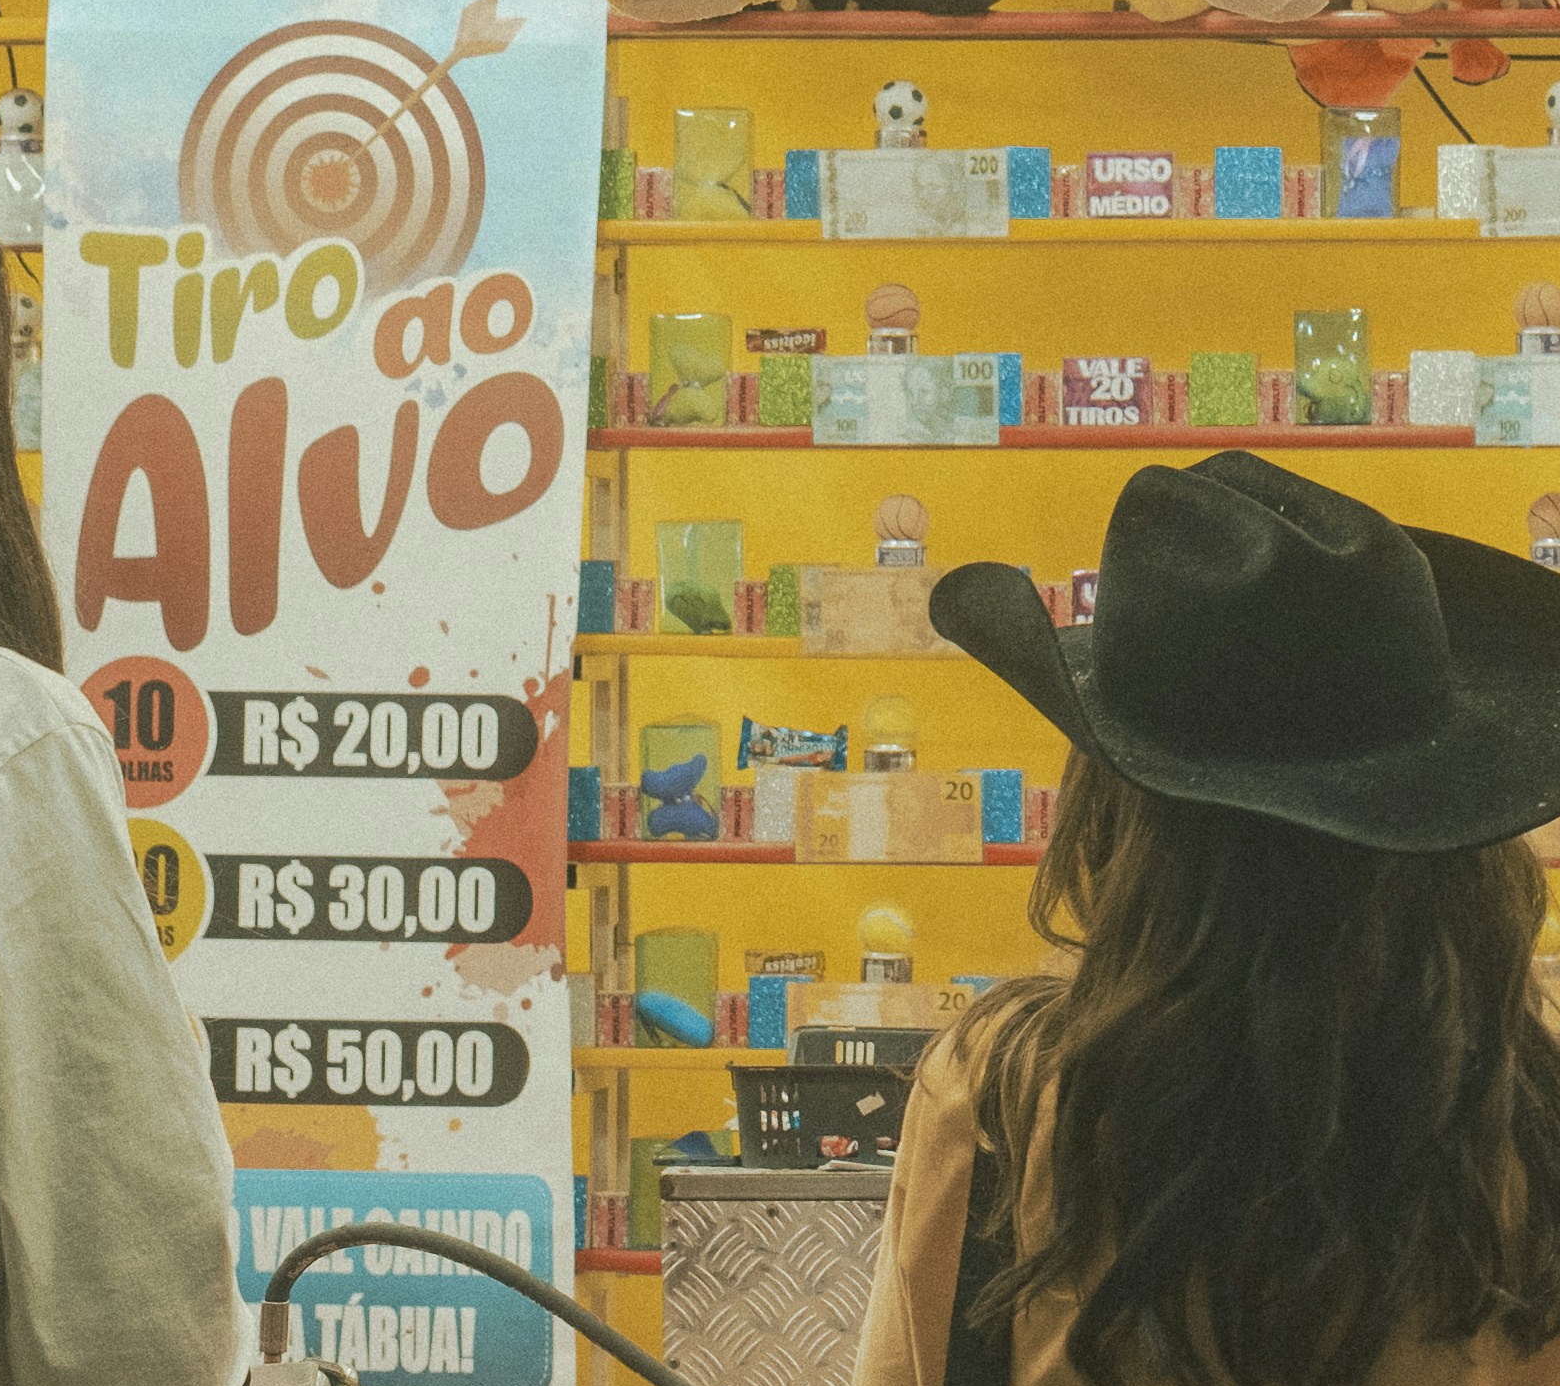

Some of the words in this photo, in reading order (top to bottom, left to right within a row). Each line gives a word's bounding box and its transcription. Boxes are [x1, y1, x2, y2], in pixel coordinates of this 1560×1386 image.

[970, 156, 999, 174] 200
[1092, 157, 1172, 183] URSO
[1090, 190, 1170, 217] MÉDIO
[79, 230, 359, 369] Tiro
[372, 272, 534, 379] ao
[959, 361, 993, 380] 100
[1077, 358, 1145, 378] VALE
[1090, 375, 1135, 401] 20
[1066, 405, 1140, 425] TIROS
[74, 370, 565, 653] Alvo
[102, 680, 175, 752] 10
[242, 696, 320, 772] R$
[332, 699, 500, 775] 20,00
[945, 781, 973, 802] 20
[237, 859, 315, 936] R$
[326, 864, 498, 940] 30,00
[938, 992, 965, 1012] 20
[234, 1023, 313, 1100] R$
[325, 1027, 495, 1103] 50,00
[314, 1291, 477, 1376] TÁBUA!
